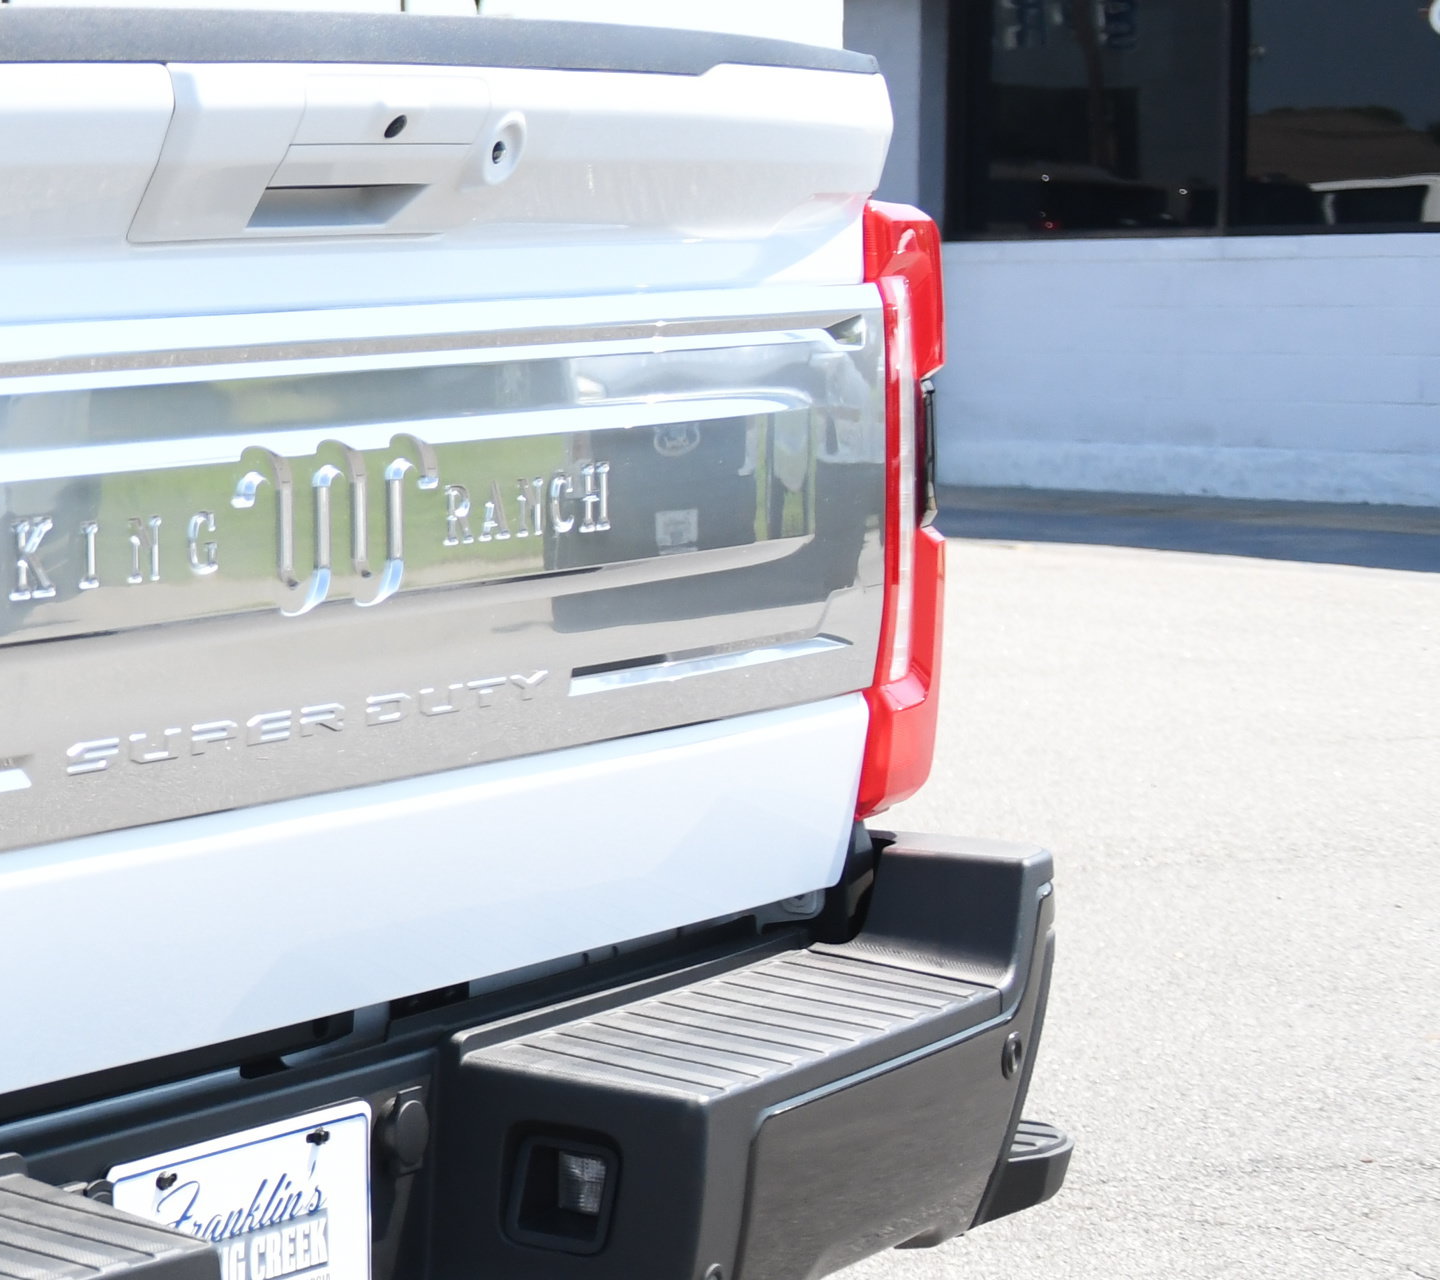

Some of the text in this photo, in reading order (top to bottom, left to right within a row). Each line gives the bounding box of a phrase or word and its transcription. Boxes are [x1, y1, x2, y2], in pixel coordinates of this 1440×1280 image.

[8, 460, 611, 601] KING RANCH
[65, 669, 549, 775] SUPER DUTY
[156, 1160, 327, 1243] Franklin's
